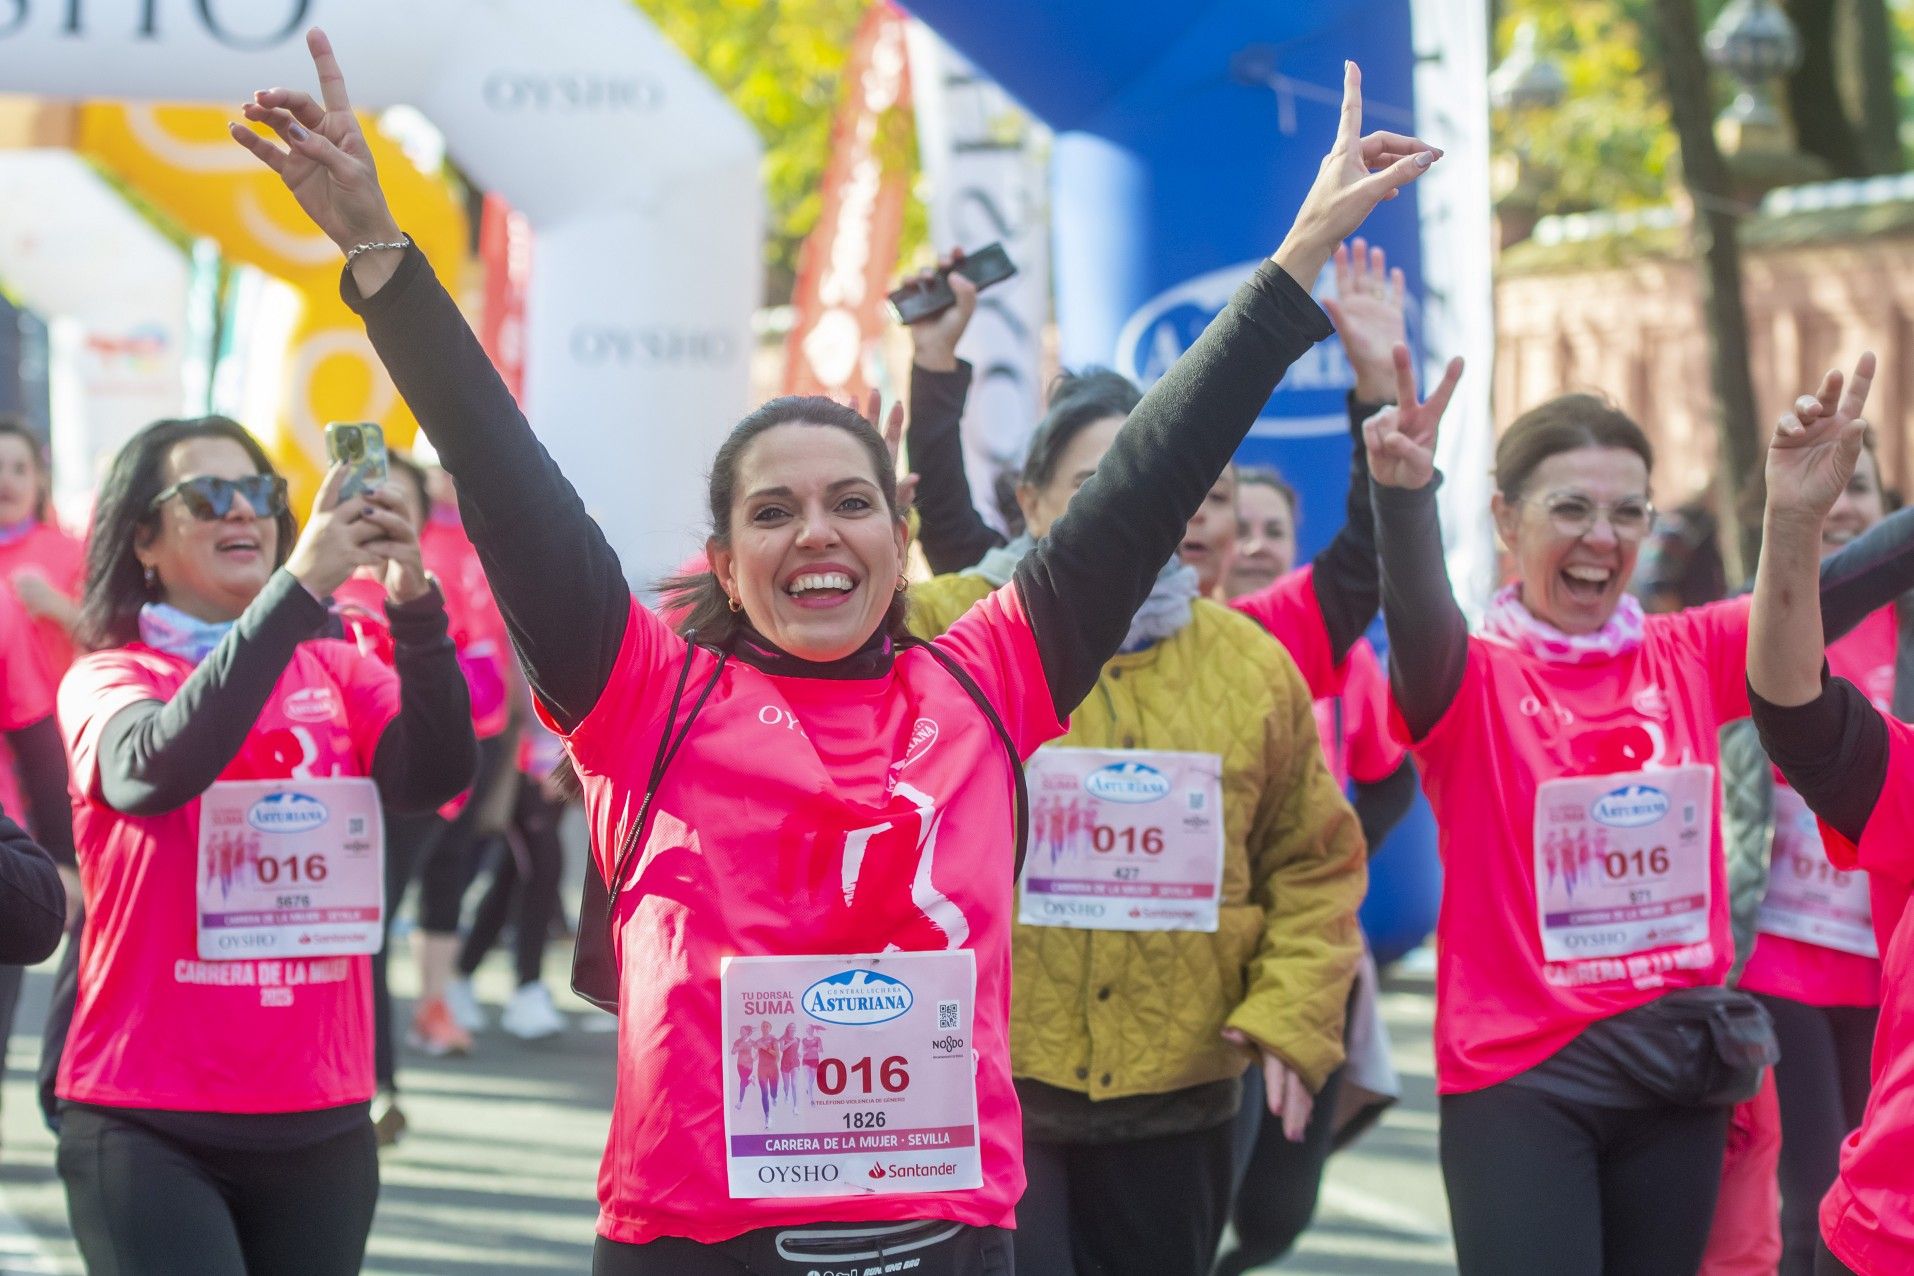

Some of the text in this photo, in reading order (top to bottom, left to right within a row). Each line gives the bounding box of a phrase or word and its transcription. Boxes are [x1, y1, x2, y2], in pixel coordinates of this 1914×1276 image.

[1093, 826, 1164, 854] 016
[257, 854, 327, 884] 016
[1604, 847, 1670, 879] 016
[1114, 867, 1139, 880] 427
[219, 934, 275, 949] OYSHO
[174, 958, 254, 986] CARRERA
[258, 961, 281, 985] DE
[284, 961, 307, 985] LA
[741, 990, 794, 1000] TU DORSAL
[811, 990, 906, 1012] ASTURIANA
[744, 1001, 795, 1015] SUMA
[816, 1055, 910, 1096] 016
[842, 1111, 886, 1129] 1826
[765, 1132, 951, 1152] CARRERA DE LA MUJER SEVILLA
[758, 1164, 839, 1184] OYSHO
[888, 1162, 957, 1179] Santander
